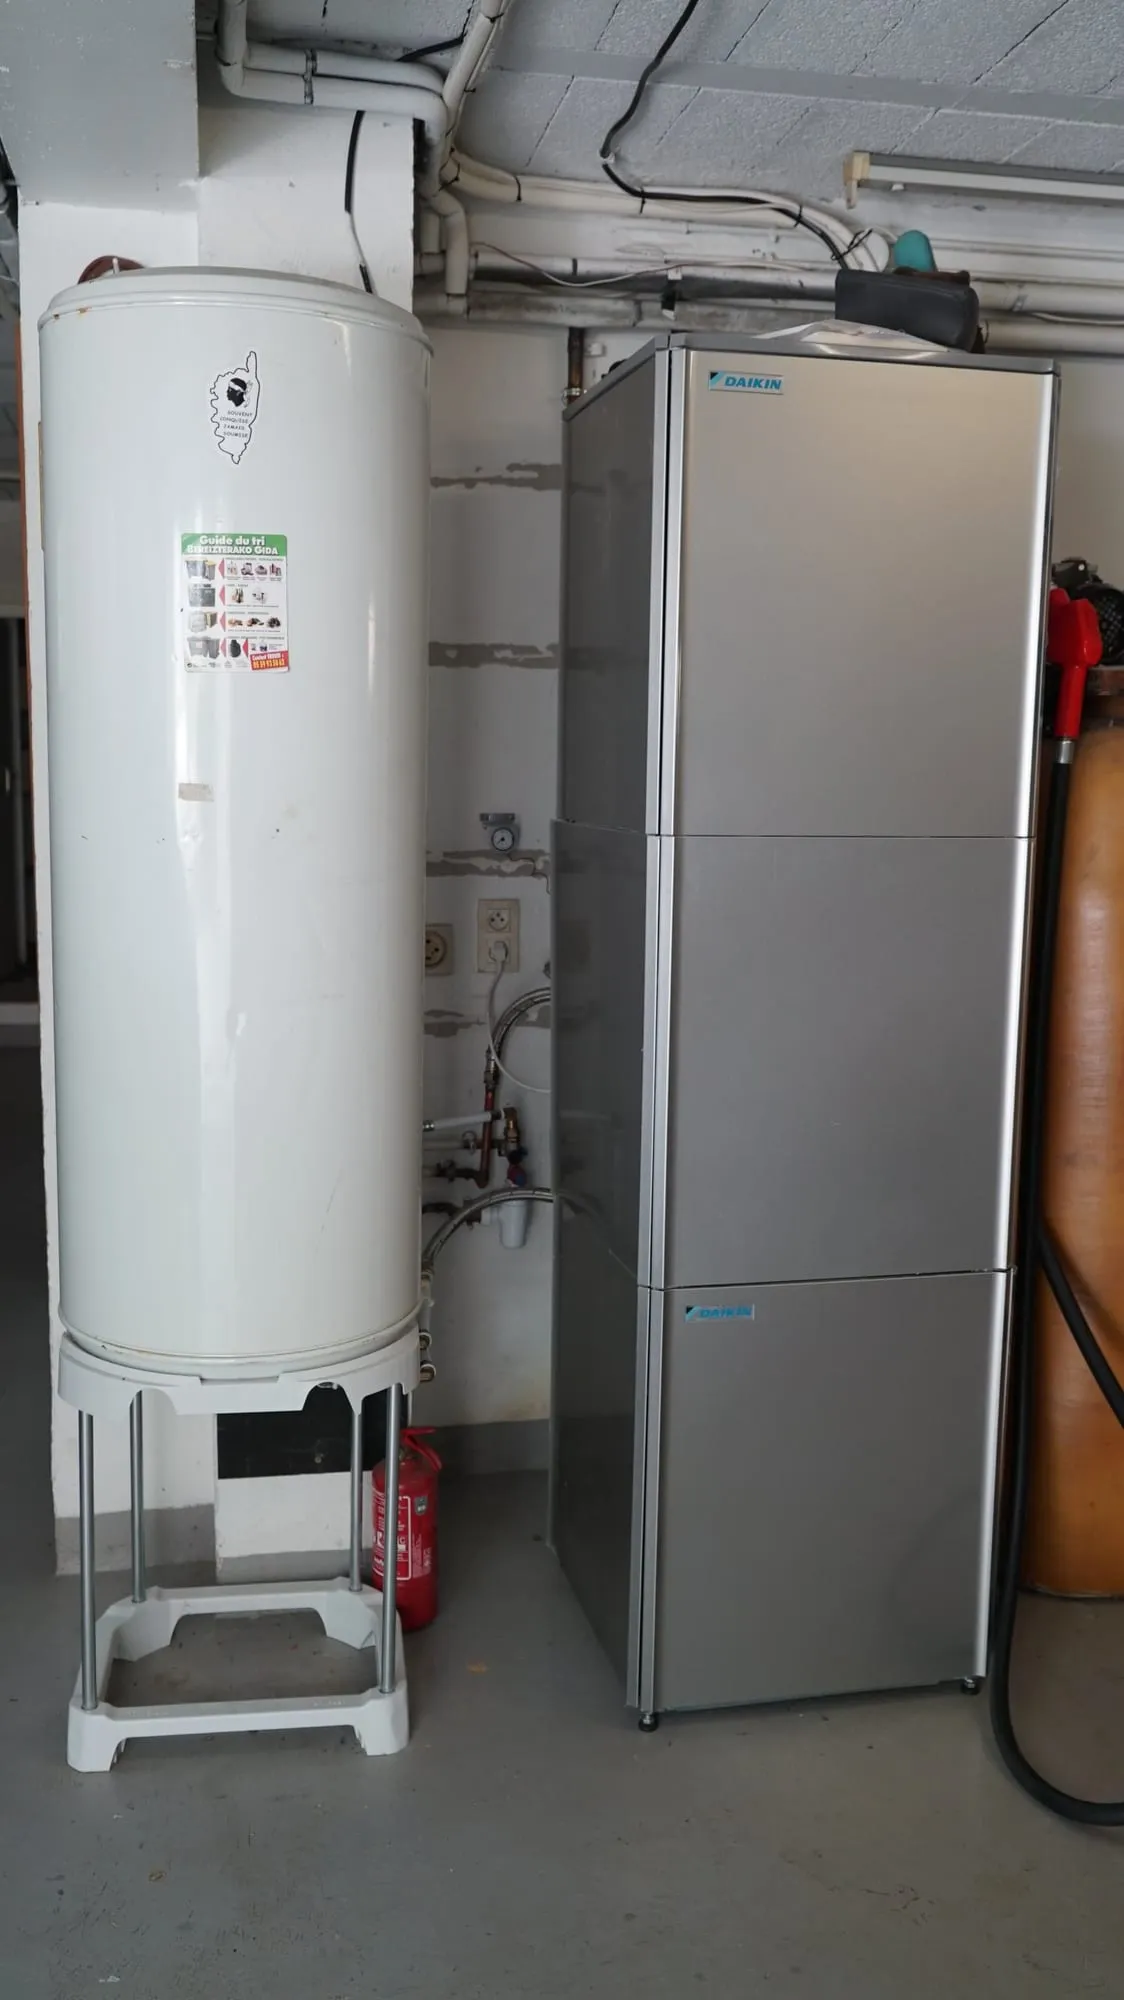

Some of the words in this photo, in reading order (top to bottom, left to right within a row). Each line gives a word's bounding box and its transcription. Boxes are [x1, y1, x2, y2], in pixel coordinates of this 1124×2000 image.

[724, 376, 782, 390] DAIKIN
[199, 535, 233, 546] Guide
[235, 535, 249, 546] du
[252, 536, 265, 546] tri
[700, 1306, 752, 1318] DAIKIN
